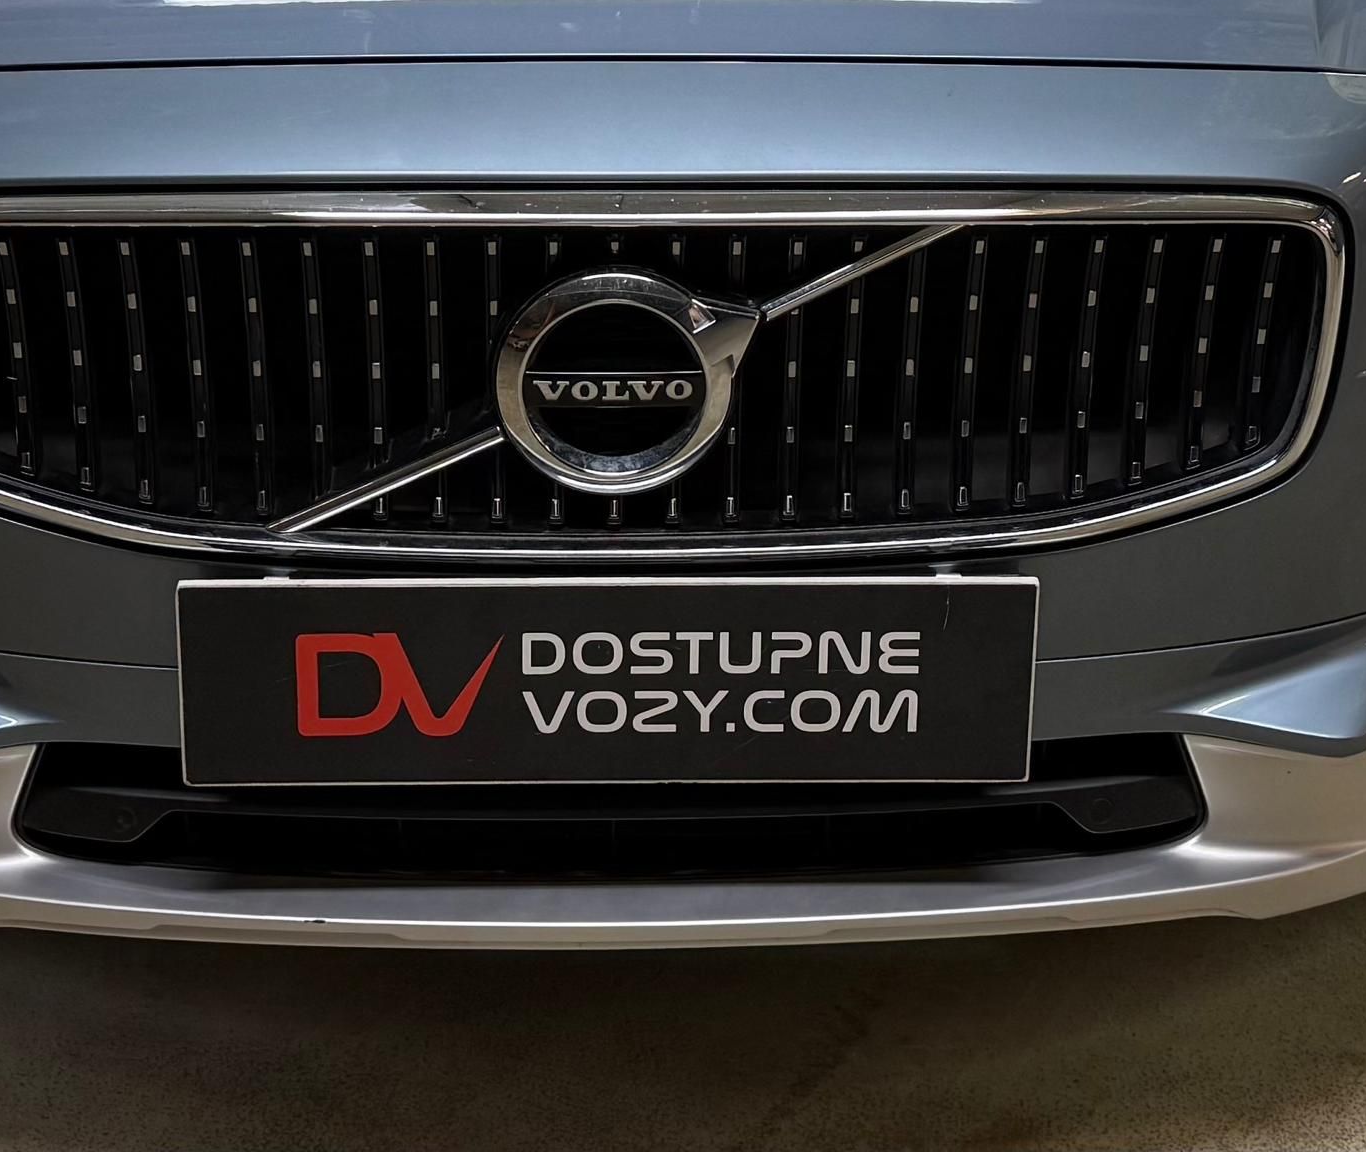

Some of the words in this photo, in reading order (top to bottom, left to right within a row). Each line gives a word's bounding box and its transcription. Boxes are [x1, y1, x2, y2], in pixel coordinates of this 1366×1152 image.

[532, 379, 694, 401] VOLVO
[294, 633, 505, 737] DV
[521, 631, 921, 676] DOSTUPNE
[522, 689, 919, 735] VOZY.COM
